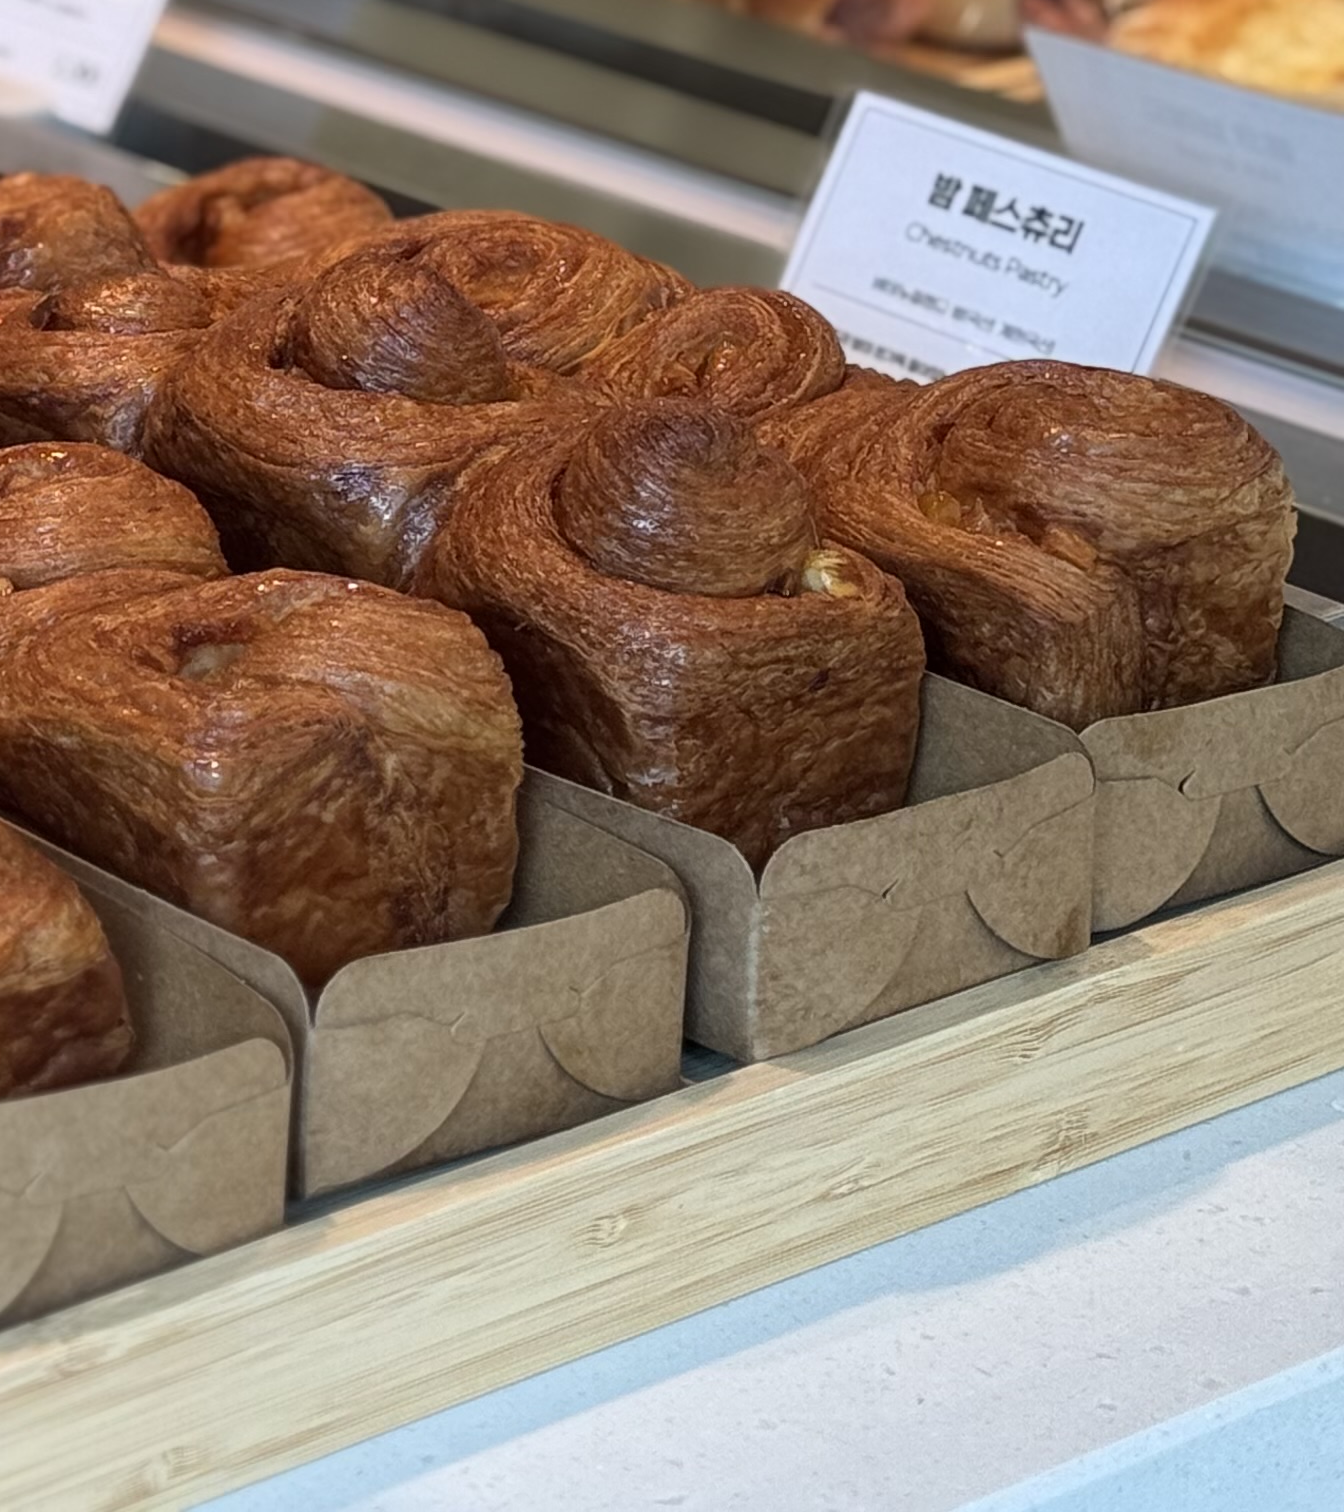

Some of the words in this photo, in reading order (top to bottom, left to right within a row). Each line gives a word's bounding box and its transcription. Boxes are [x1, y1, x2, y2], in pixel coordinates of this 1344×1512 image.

[928, 172, 963, 211] 밤
[962, 184, 1085, 255] 페스츄리
[905, 221, 1001, 272] Chestnuts
[1005, 256, 1069, 298] Pastry
